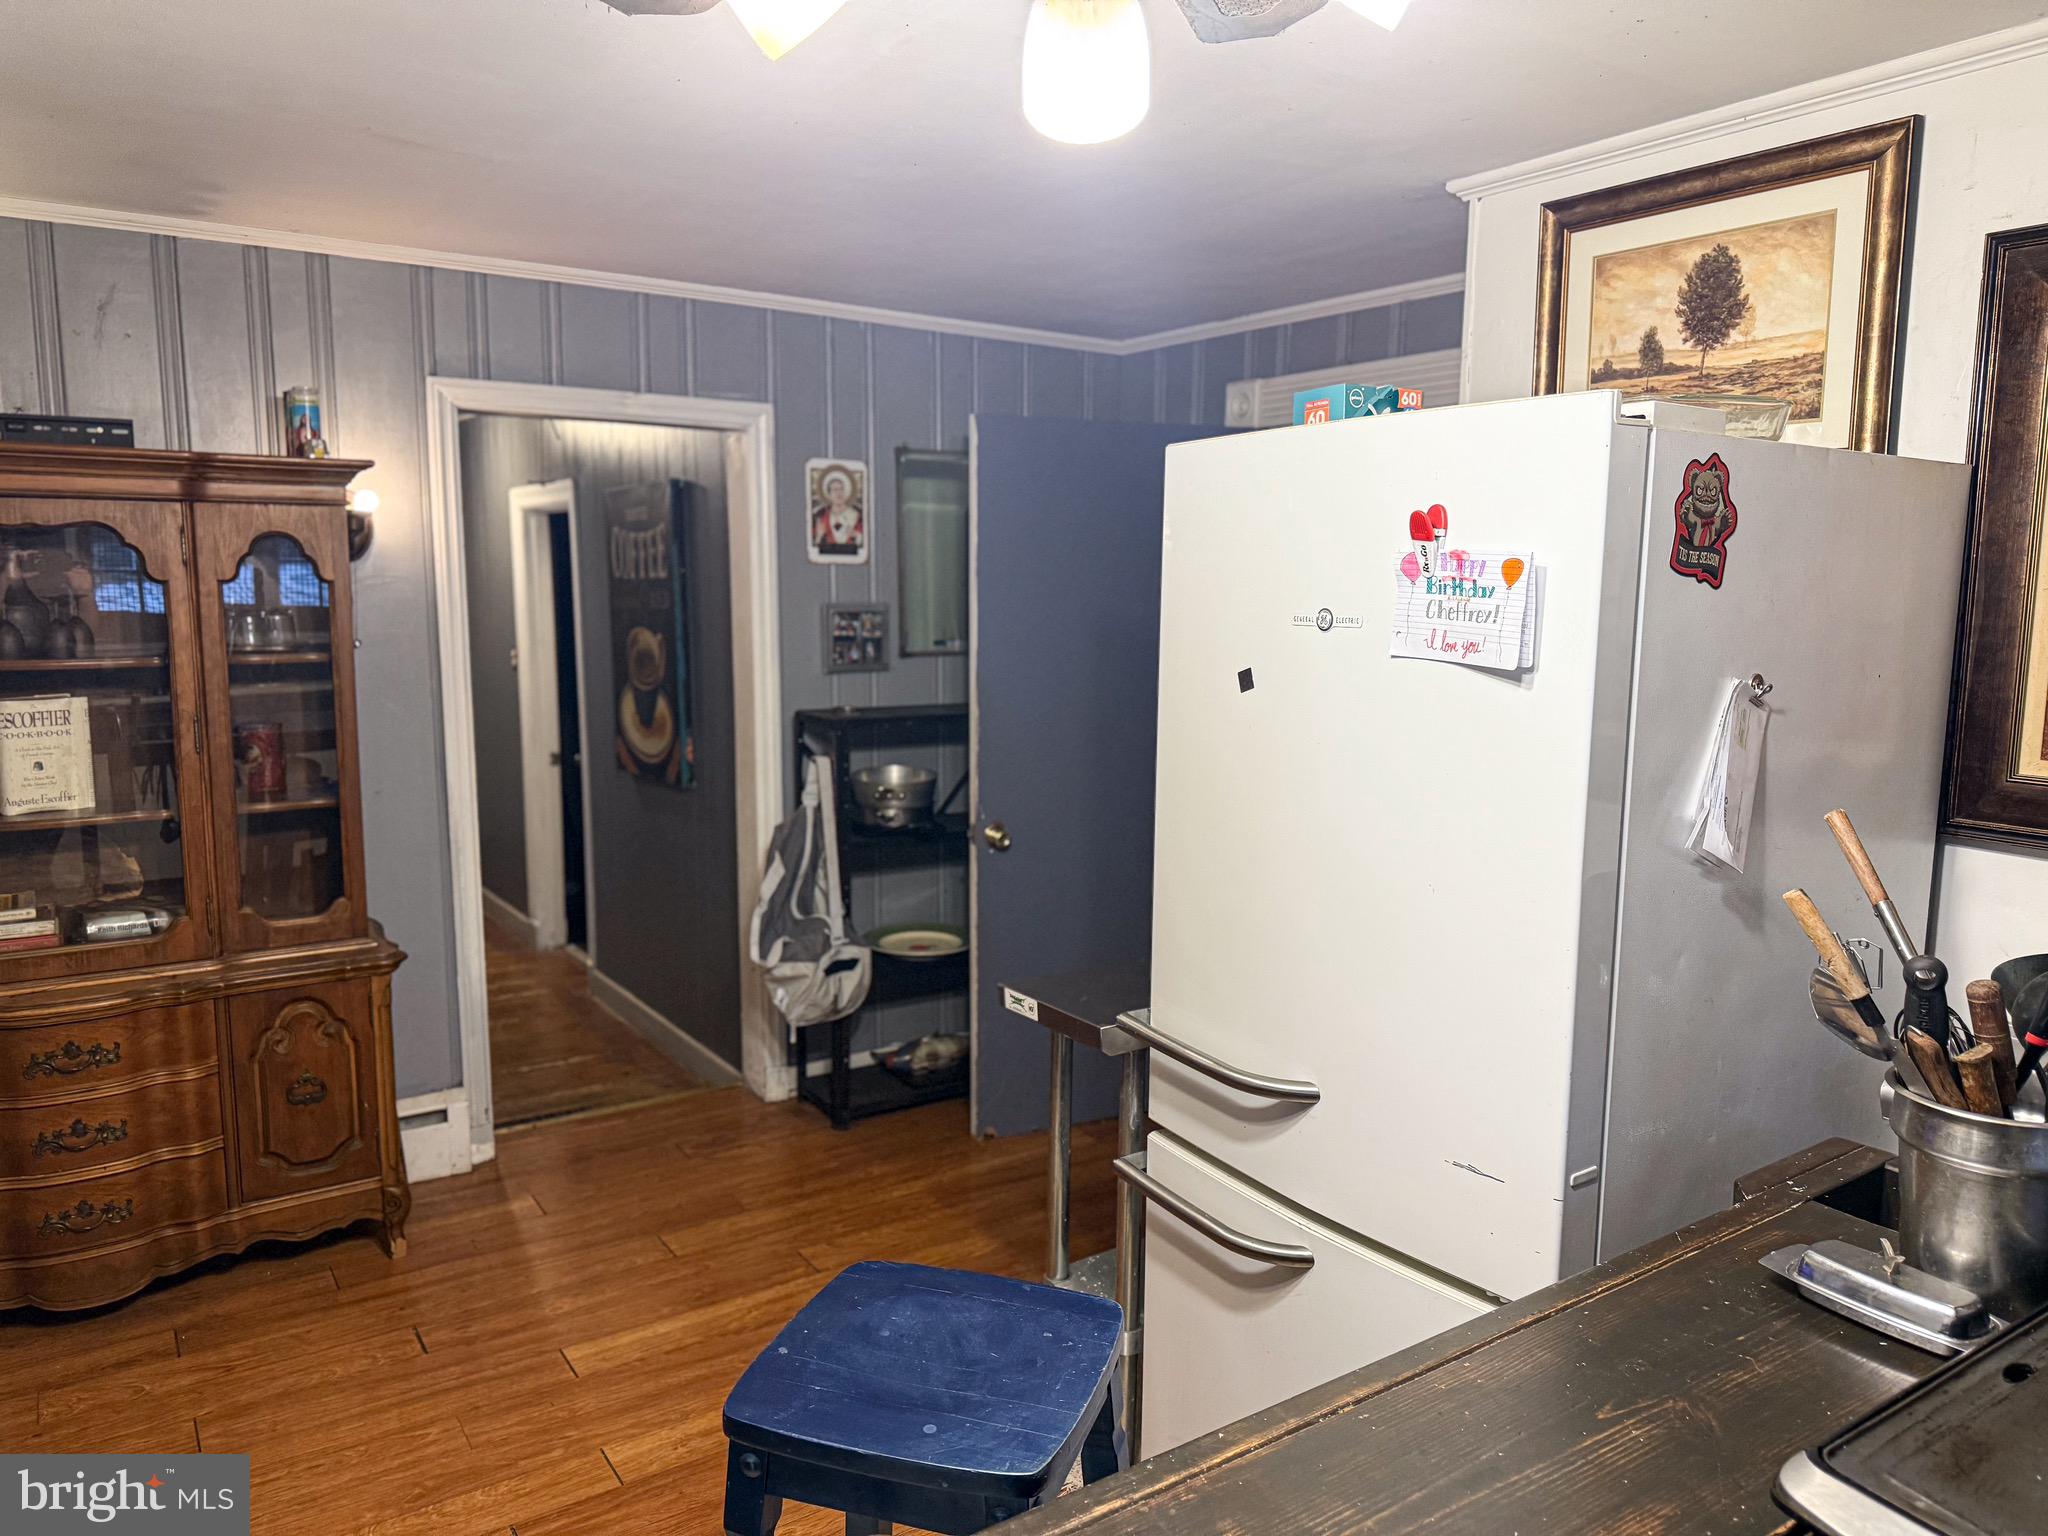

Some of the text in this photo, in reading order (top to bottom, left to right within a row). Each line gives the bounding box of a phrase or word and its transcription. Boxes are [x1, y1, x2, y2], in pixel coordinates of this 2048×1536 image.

[1400, 390, 1417, 406] 60
[1689, 551, 1700, 563] THE
[1700, 552, 1720, 567] SEASON
[1426, 575, 1495, 599] Birthday
[1293, 615, 1315, 623] GENERAL
[1335, 616, 1360, 625] ELECTRIC
[1426, 599, 1500, 624] Cheffrey!
[1440, 630, 1458, 652] love
[4, 789, 77, 808] Auguste Escoffier
